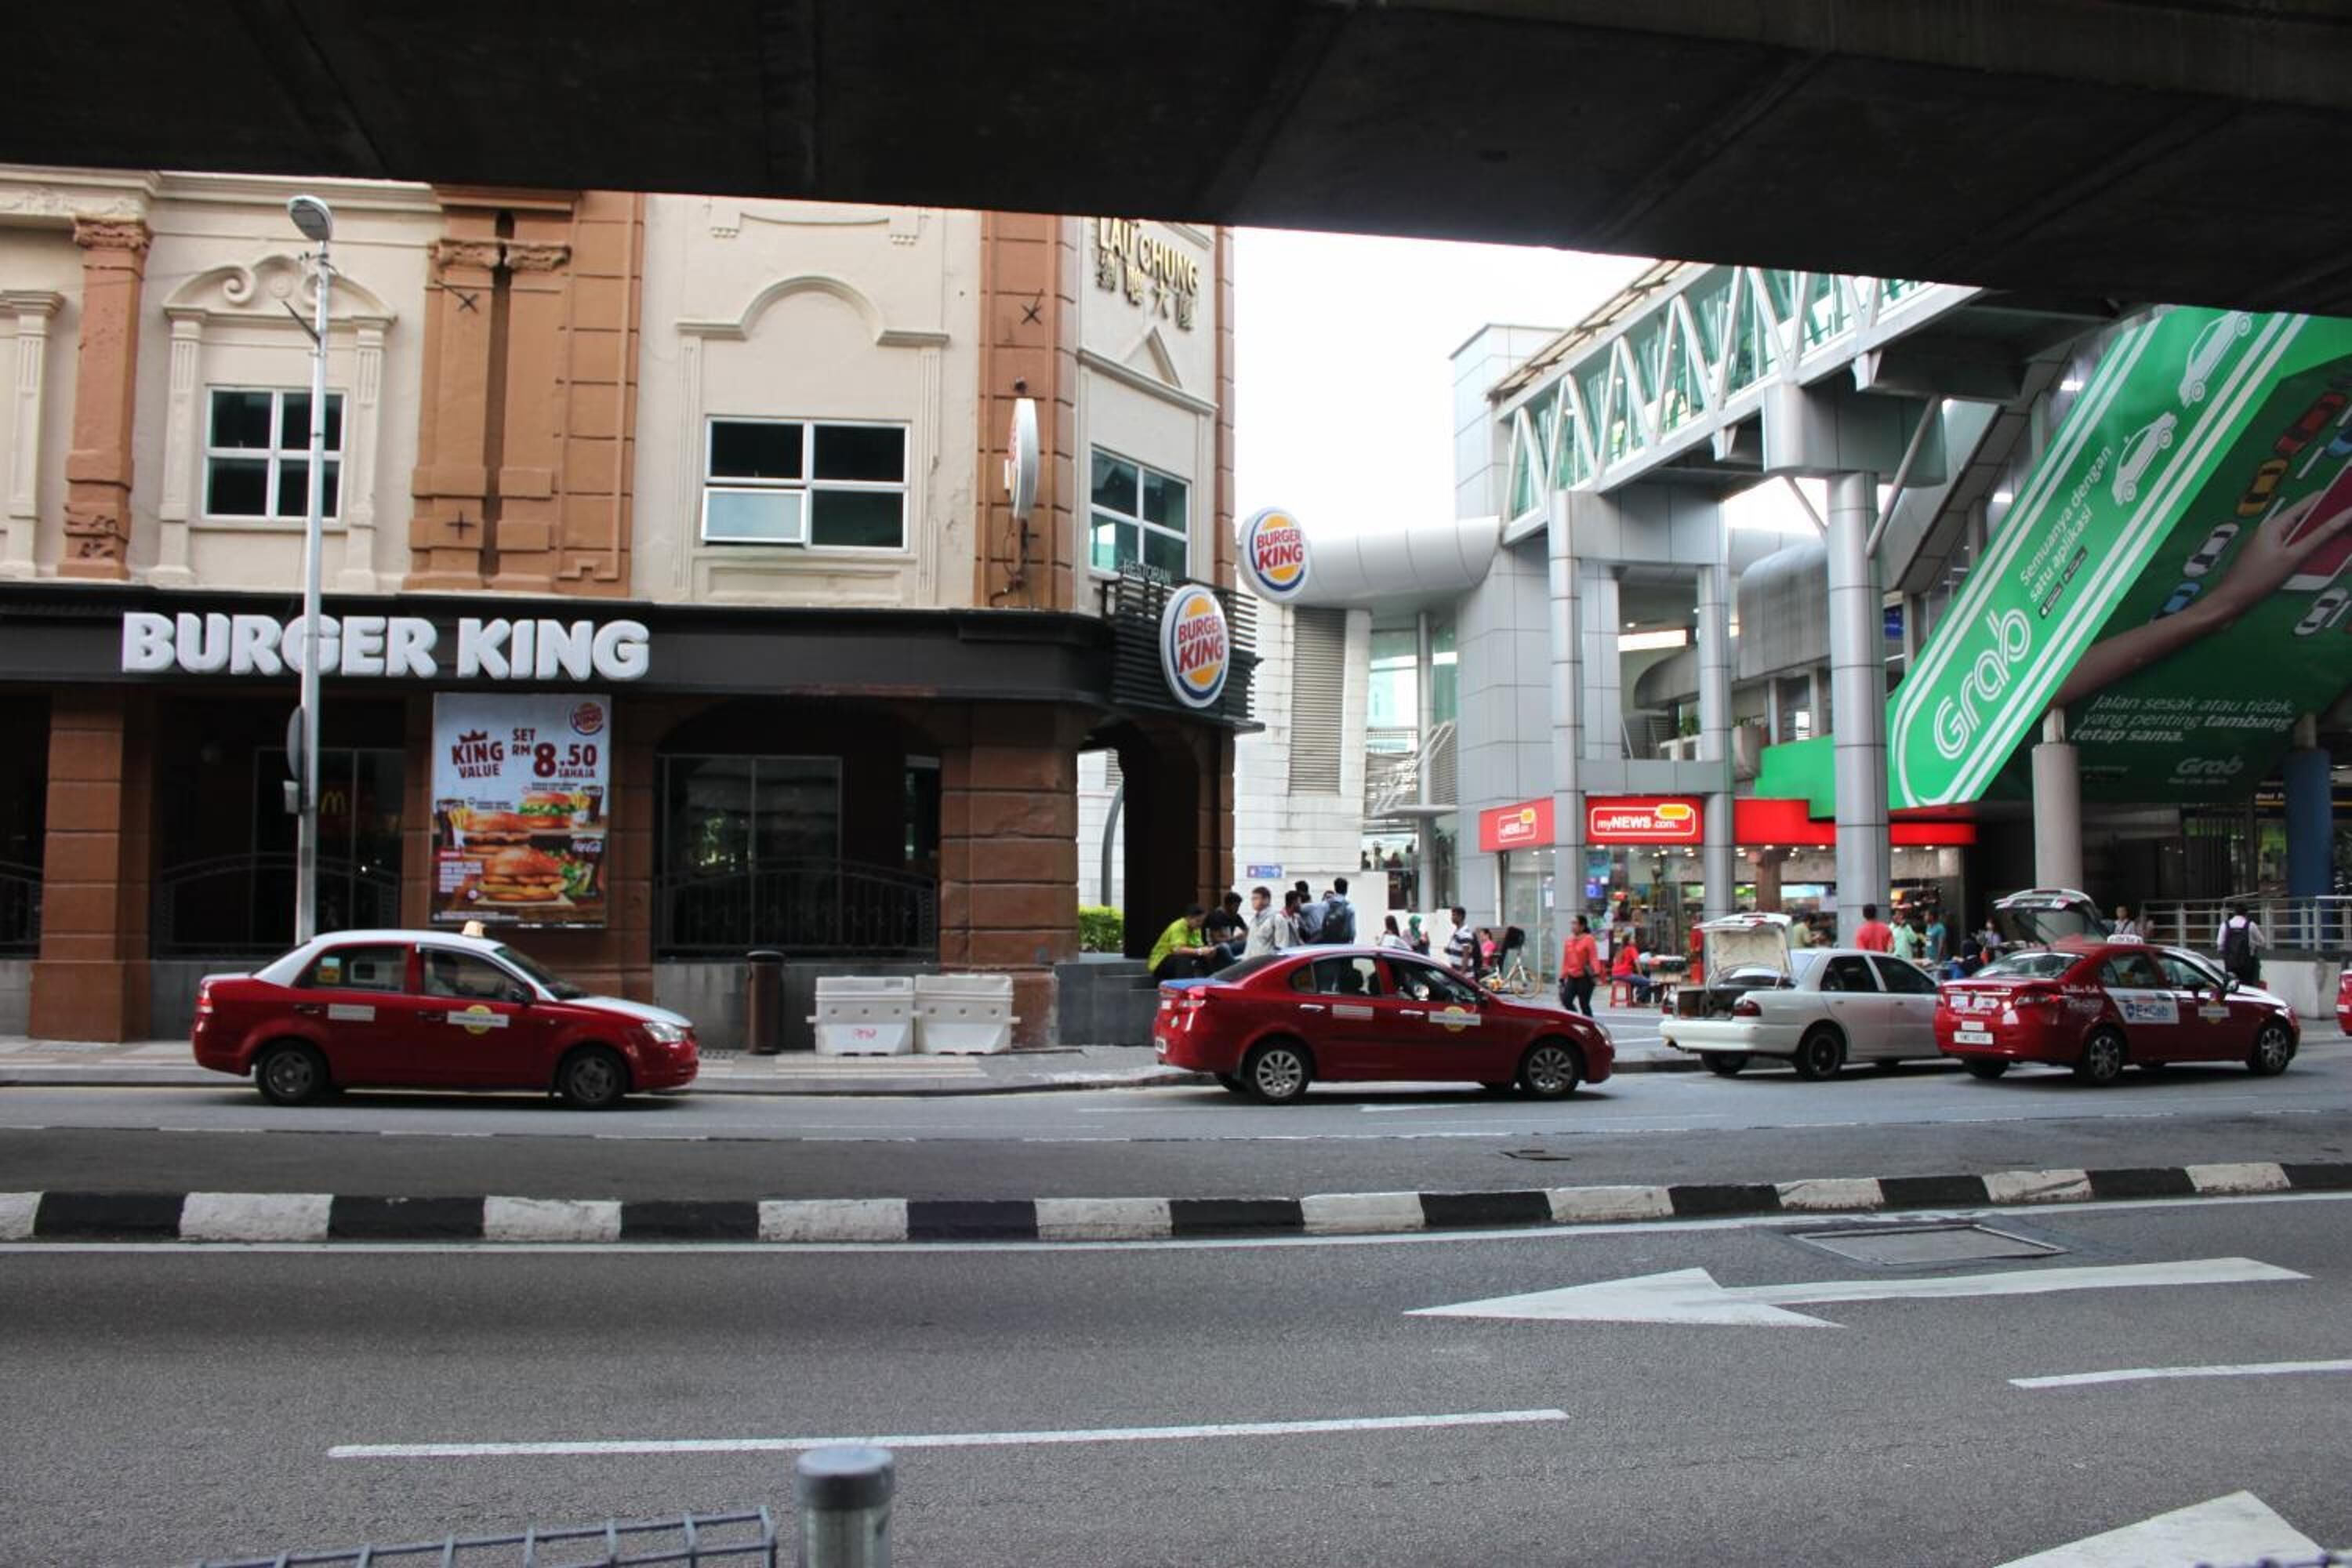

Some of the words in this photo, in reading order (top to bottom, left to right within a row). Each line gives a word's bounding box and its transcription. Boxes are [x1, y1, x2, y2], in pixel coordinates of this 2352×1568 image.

[1139, 236, 1199, 296] CHUNG
[2020, 507, 2072, 586] Semuanya
[2071, 446, 2111, 508] dengan
[1257, 529, 1301, 547] BURGER
[1258, 544, 1304, 572] KING
[2030, 567, 2054, 602] satu
[2053, 503, 2092, 569] aplikasi
[122, 613, 437, 677] BURGER
[458, 618, 649, 681] KING
[1178, 637, 1224, 673] KING
[1933, 608, 2031, 760] Grab
[2091, 695, 2140, 711] Jalan
[2145, 696, 2195, 711] sesak
[2203, 699, 2243, 711] atau
[512, 728, 536, 742] SET
[2071, 729, 2126, 743] tetap
[2082, 714, 2128, 728] yang
[2127, 714, 2202, 730] penting
[2204, 714, 2295, 732] tambang
[451, 741, 504, 766] KING
[512, 745, 531, 756] RM
[533, 742, 597, 778] 8.50
[2176, 755, 2245, 775] Grab
[459, 764, 501, 779] VALUE
